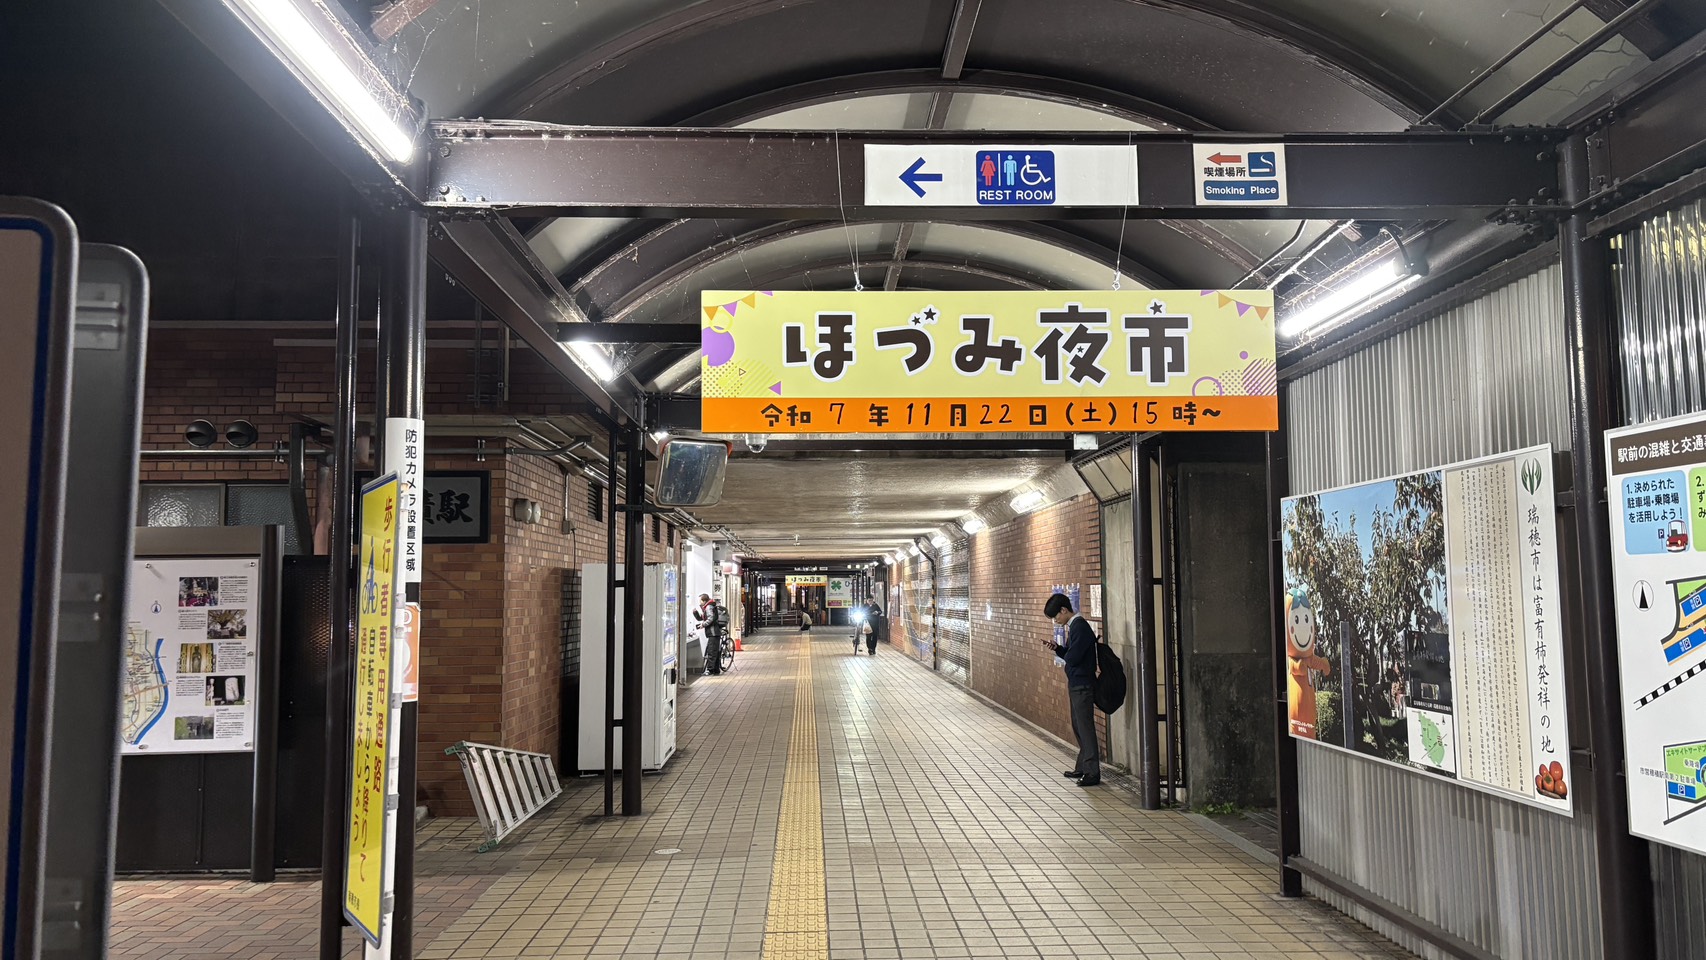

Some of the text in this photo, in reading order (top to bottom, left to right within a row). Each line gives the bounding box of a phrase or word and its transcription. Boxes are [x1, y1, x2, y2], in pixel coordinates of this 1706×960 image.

[979, 190, 1054, 201] REST ROOM
[1203, 166, 1247, 178] 喫煙場所
[1205, 185, 1277, 196] Smoking Place
[784, 302, 1191, 385] ほづみ夜市
[1617, 433, 1706, 463] 駅前の混雑と交通
[405, 428, 418, 572] 防犯カメラ設置区域
[424, 489, 474, 525] 駅
[1627, 492, 1680, 509] 駐車場・乗降場
[373, 495, 393, 794] 歩行者専用通路
[1527, 503, 1555, 754] 瑞穂市は富有柿発祥の地
[354, 627, 368, 842] 通行しましょう
[360, 628, 376, 883] 自転車から降りて
